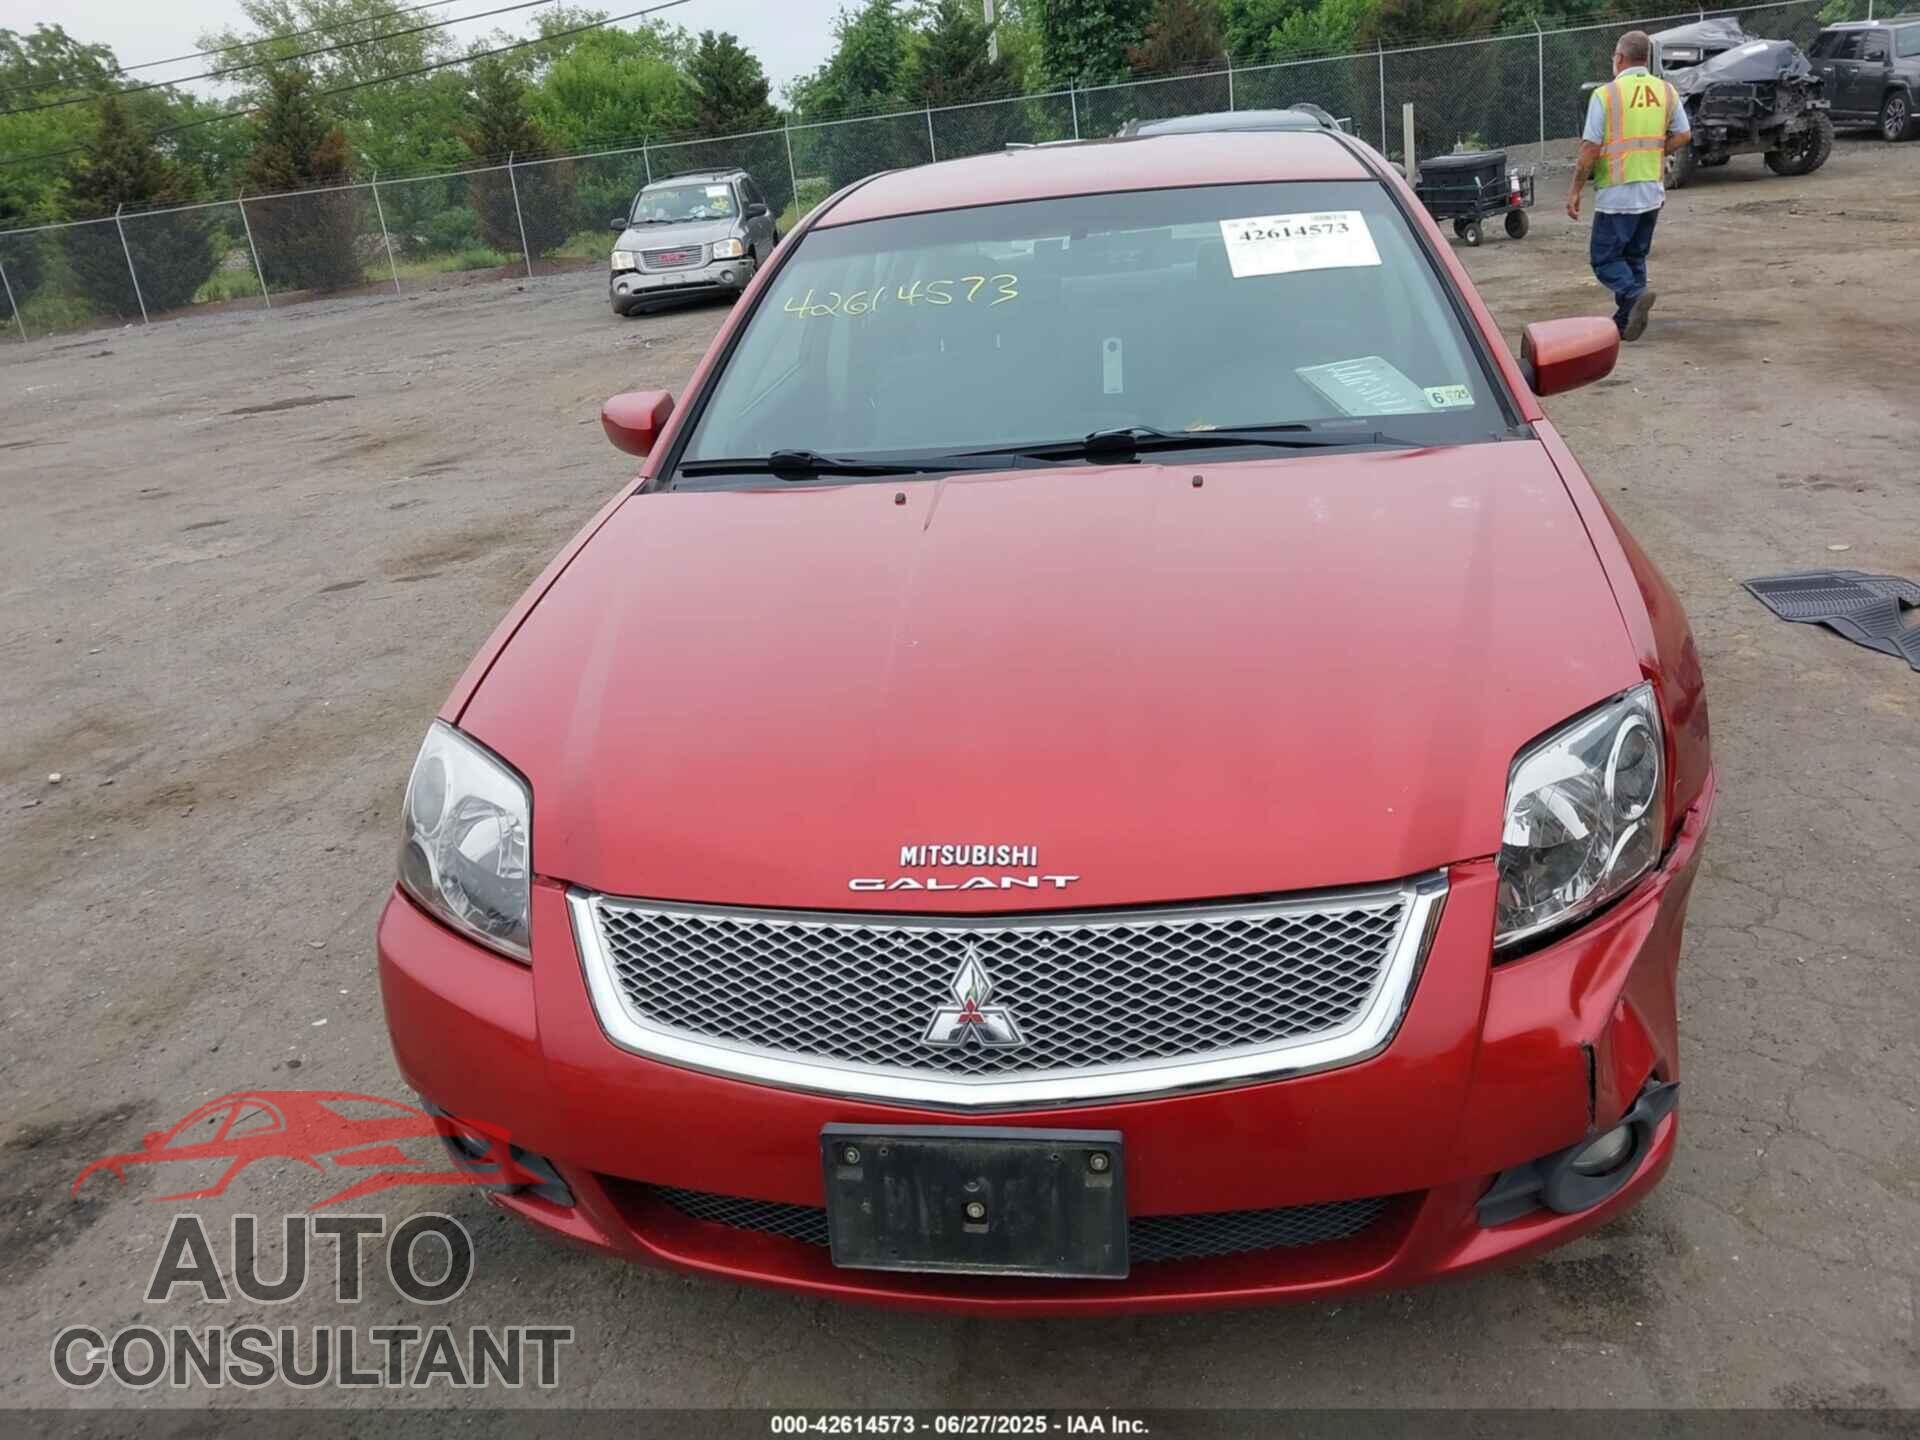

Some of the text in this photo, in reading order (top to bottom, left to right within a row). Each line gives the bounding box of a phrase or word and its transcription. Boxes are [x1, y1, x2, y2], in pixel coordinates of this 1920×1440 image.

[1239, 222, 1350, 241] 42614573
[900, 844, 1038, 867] MITSUBISHI
[848, 874, 1080, 891] GALANT
